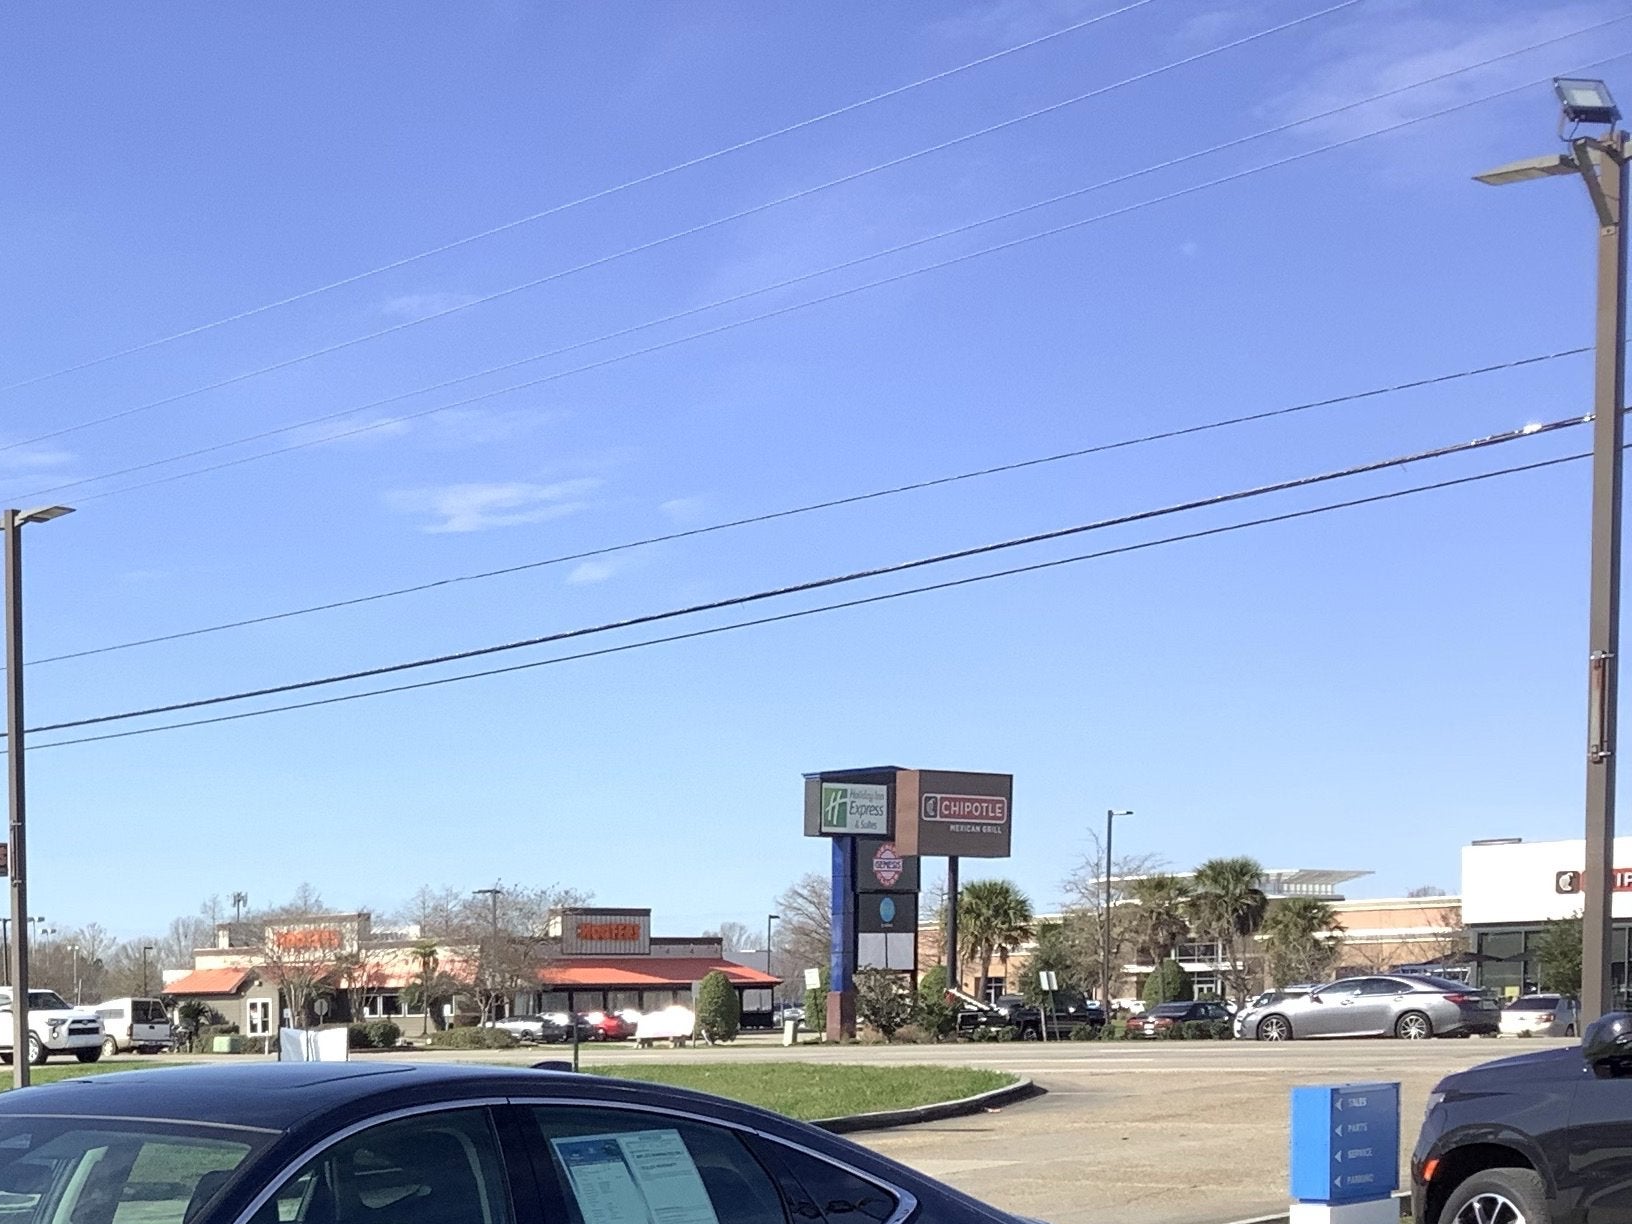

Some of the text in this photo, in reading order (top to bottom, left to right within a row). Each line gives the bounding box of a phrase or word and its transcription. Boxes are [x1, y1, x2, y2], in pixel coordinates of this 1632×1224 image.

[849, 801, 884, 818] Express
[941, 801, 1003, 817] CHIPOTLE
[950, 824, 1002, 834] MEXICAN GRILL
